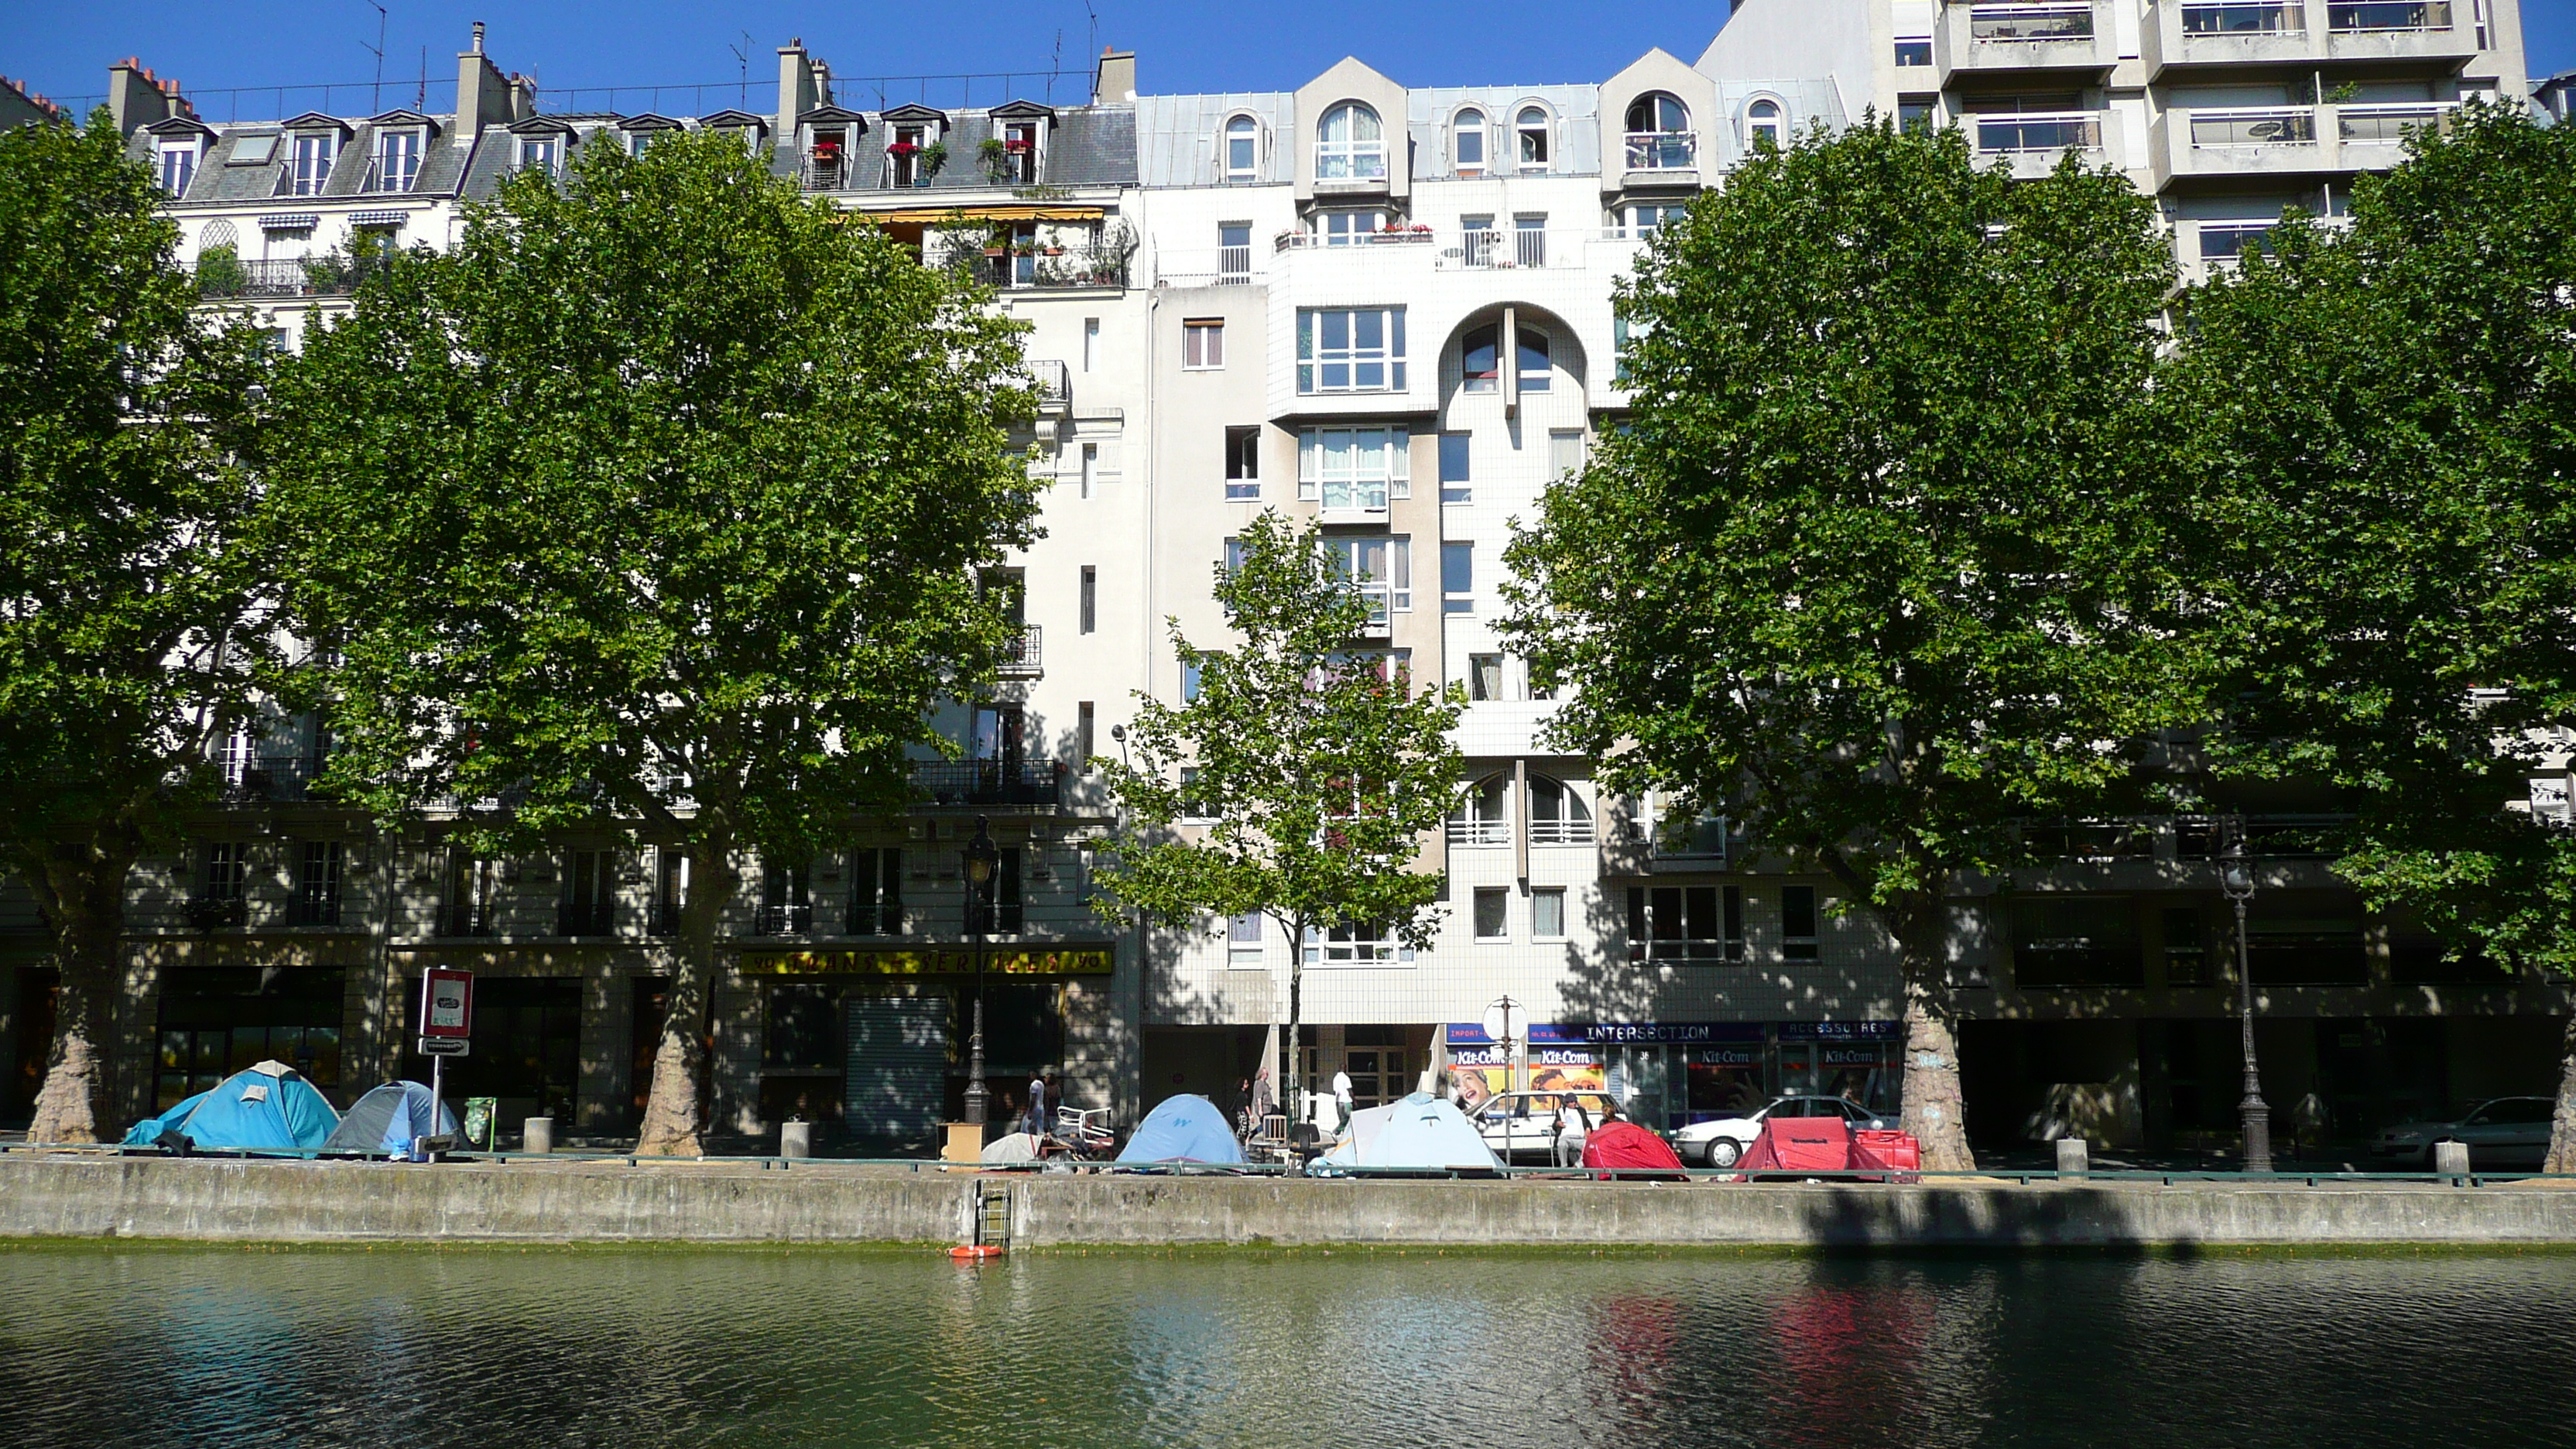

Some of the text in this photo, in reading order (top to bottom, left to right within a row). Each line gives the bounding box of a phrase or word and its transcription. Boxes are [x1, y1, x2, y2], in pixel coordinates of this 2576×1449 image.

[791, 953, 876, 972] TRANS
[1586, 1026, 1710, 1040] INTERSECTION
[1789, 1023, 1887, 1033] ACCESSOIRES
[1541, 1050, 1591, 1065] Kit-Com
[1702, 1050, 1750, 1063] Kit-Com
[1824, 1050, 1873, 1064] Kit-Com
